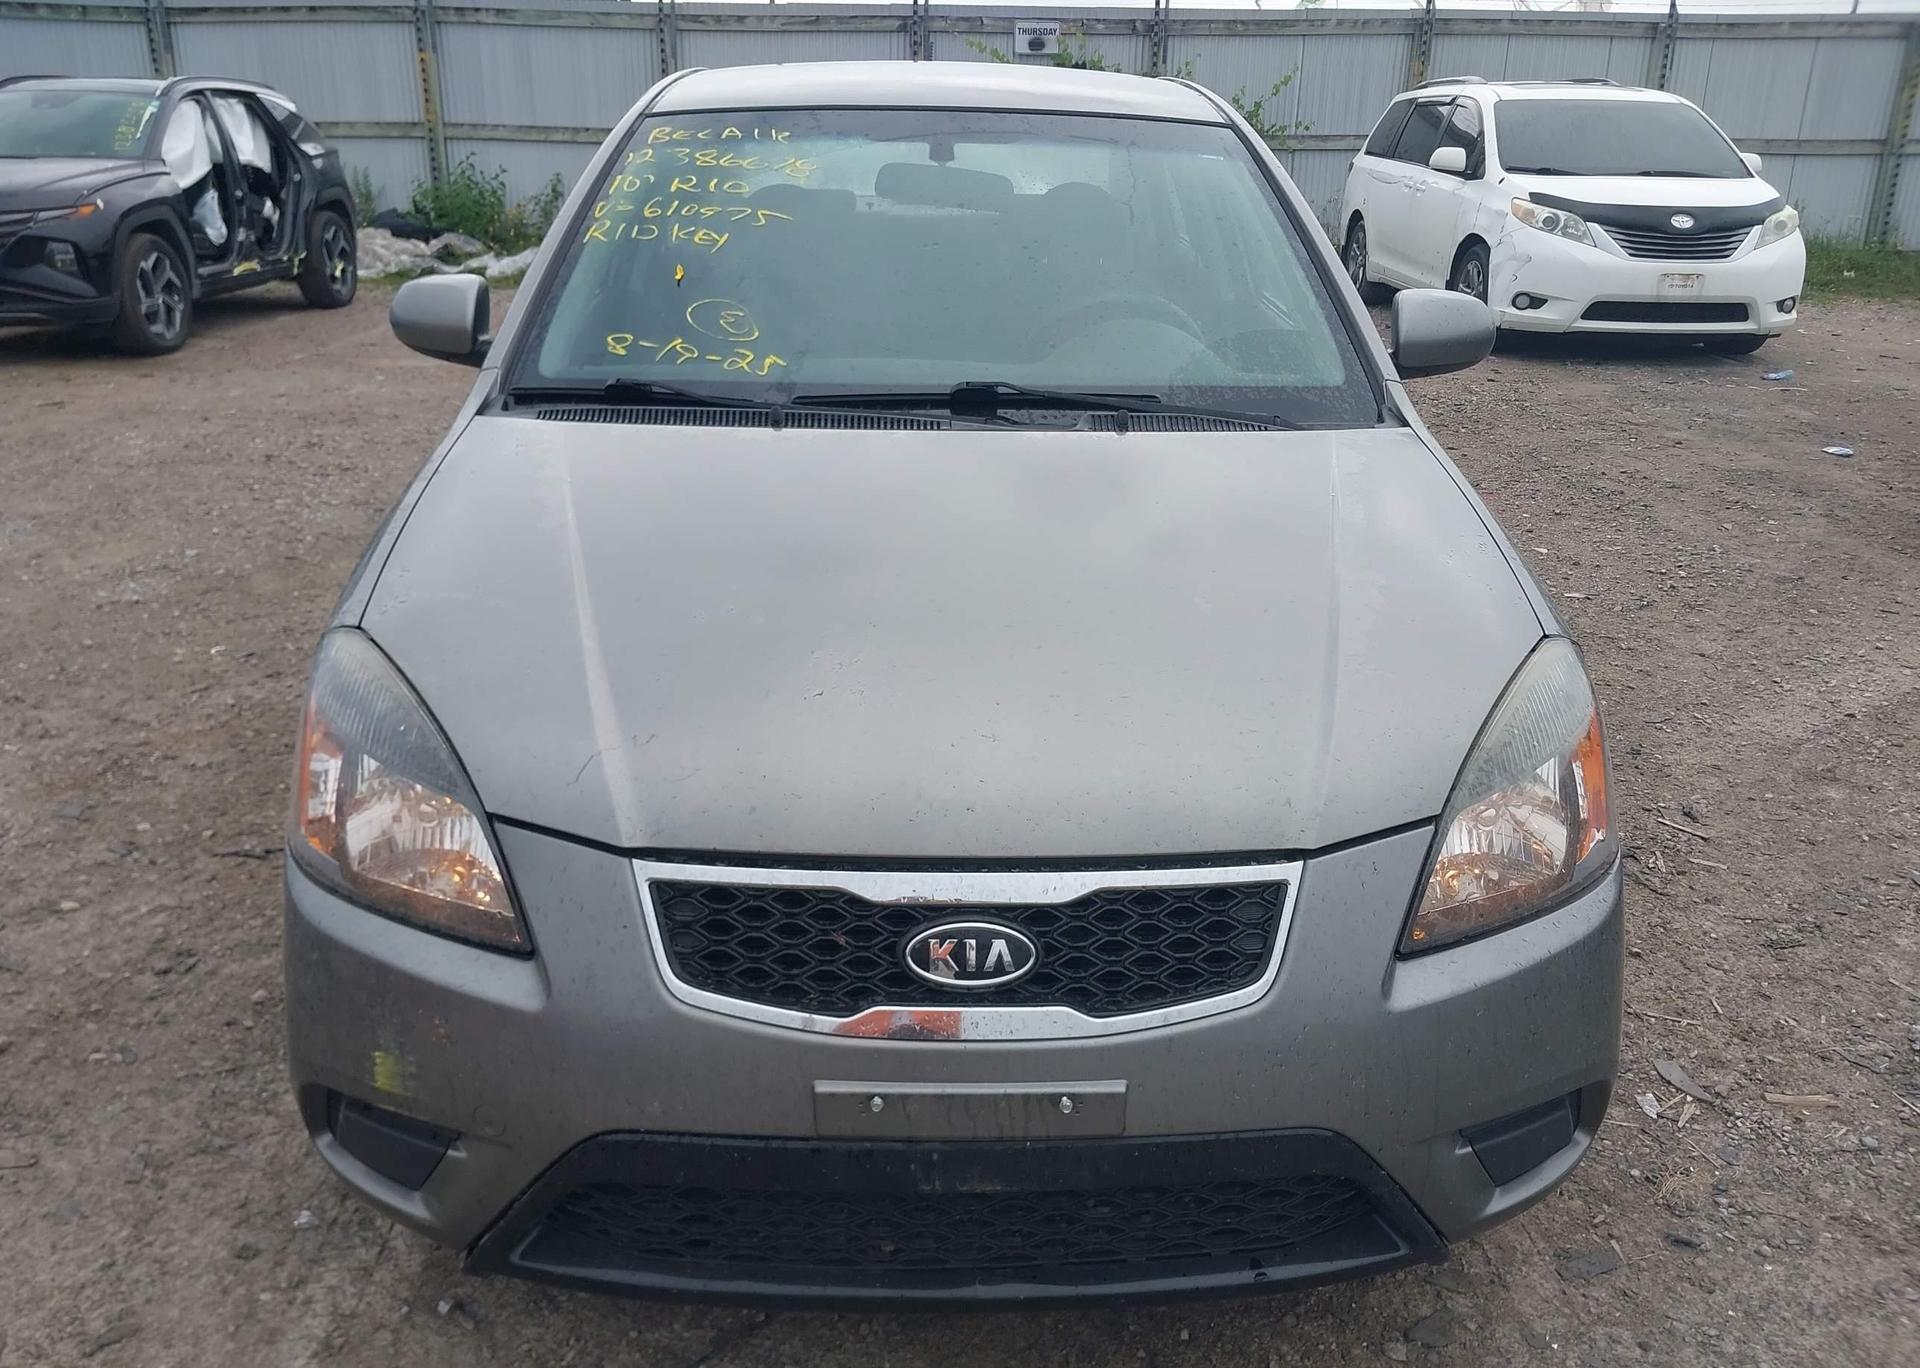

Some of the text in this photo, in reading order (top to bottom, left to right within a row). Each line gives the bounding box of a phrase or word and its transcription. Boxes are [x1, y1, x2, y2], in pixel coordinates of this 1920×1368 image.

[1017, 27, 1058, 36] THURSDAY
[671, 223, 729, 254] KEY
[927, 938, 1016, 973] KIA
